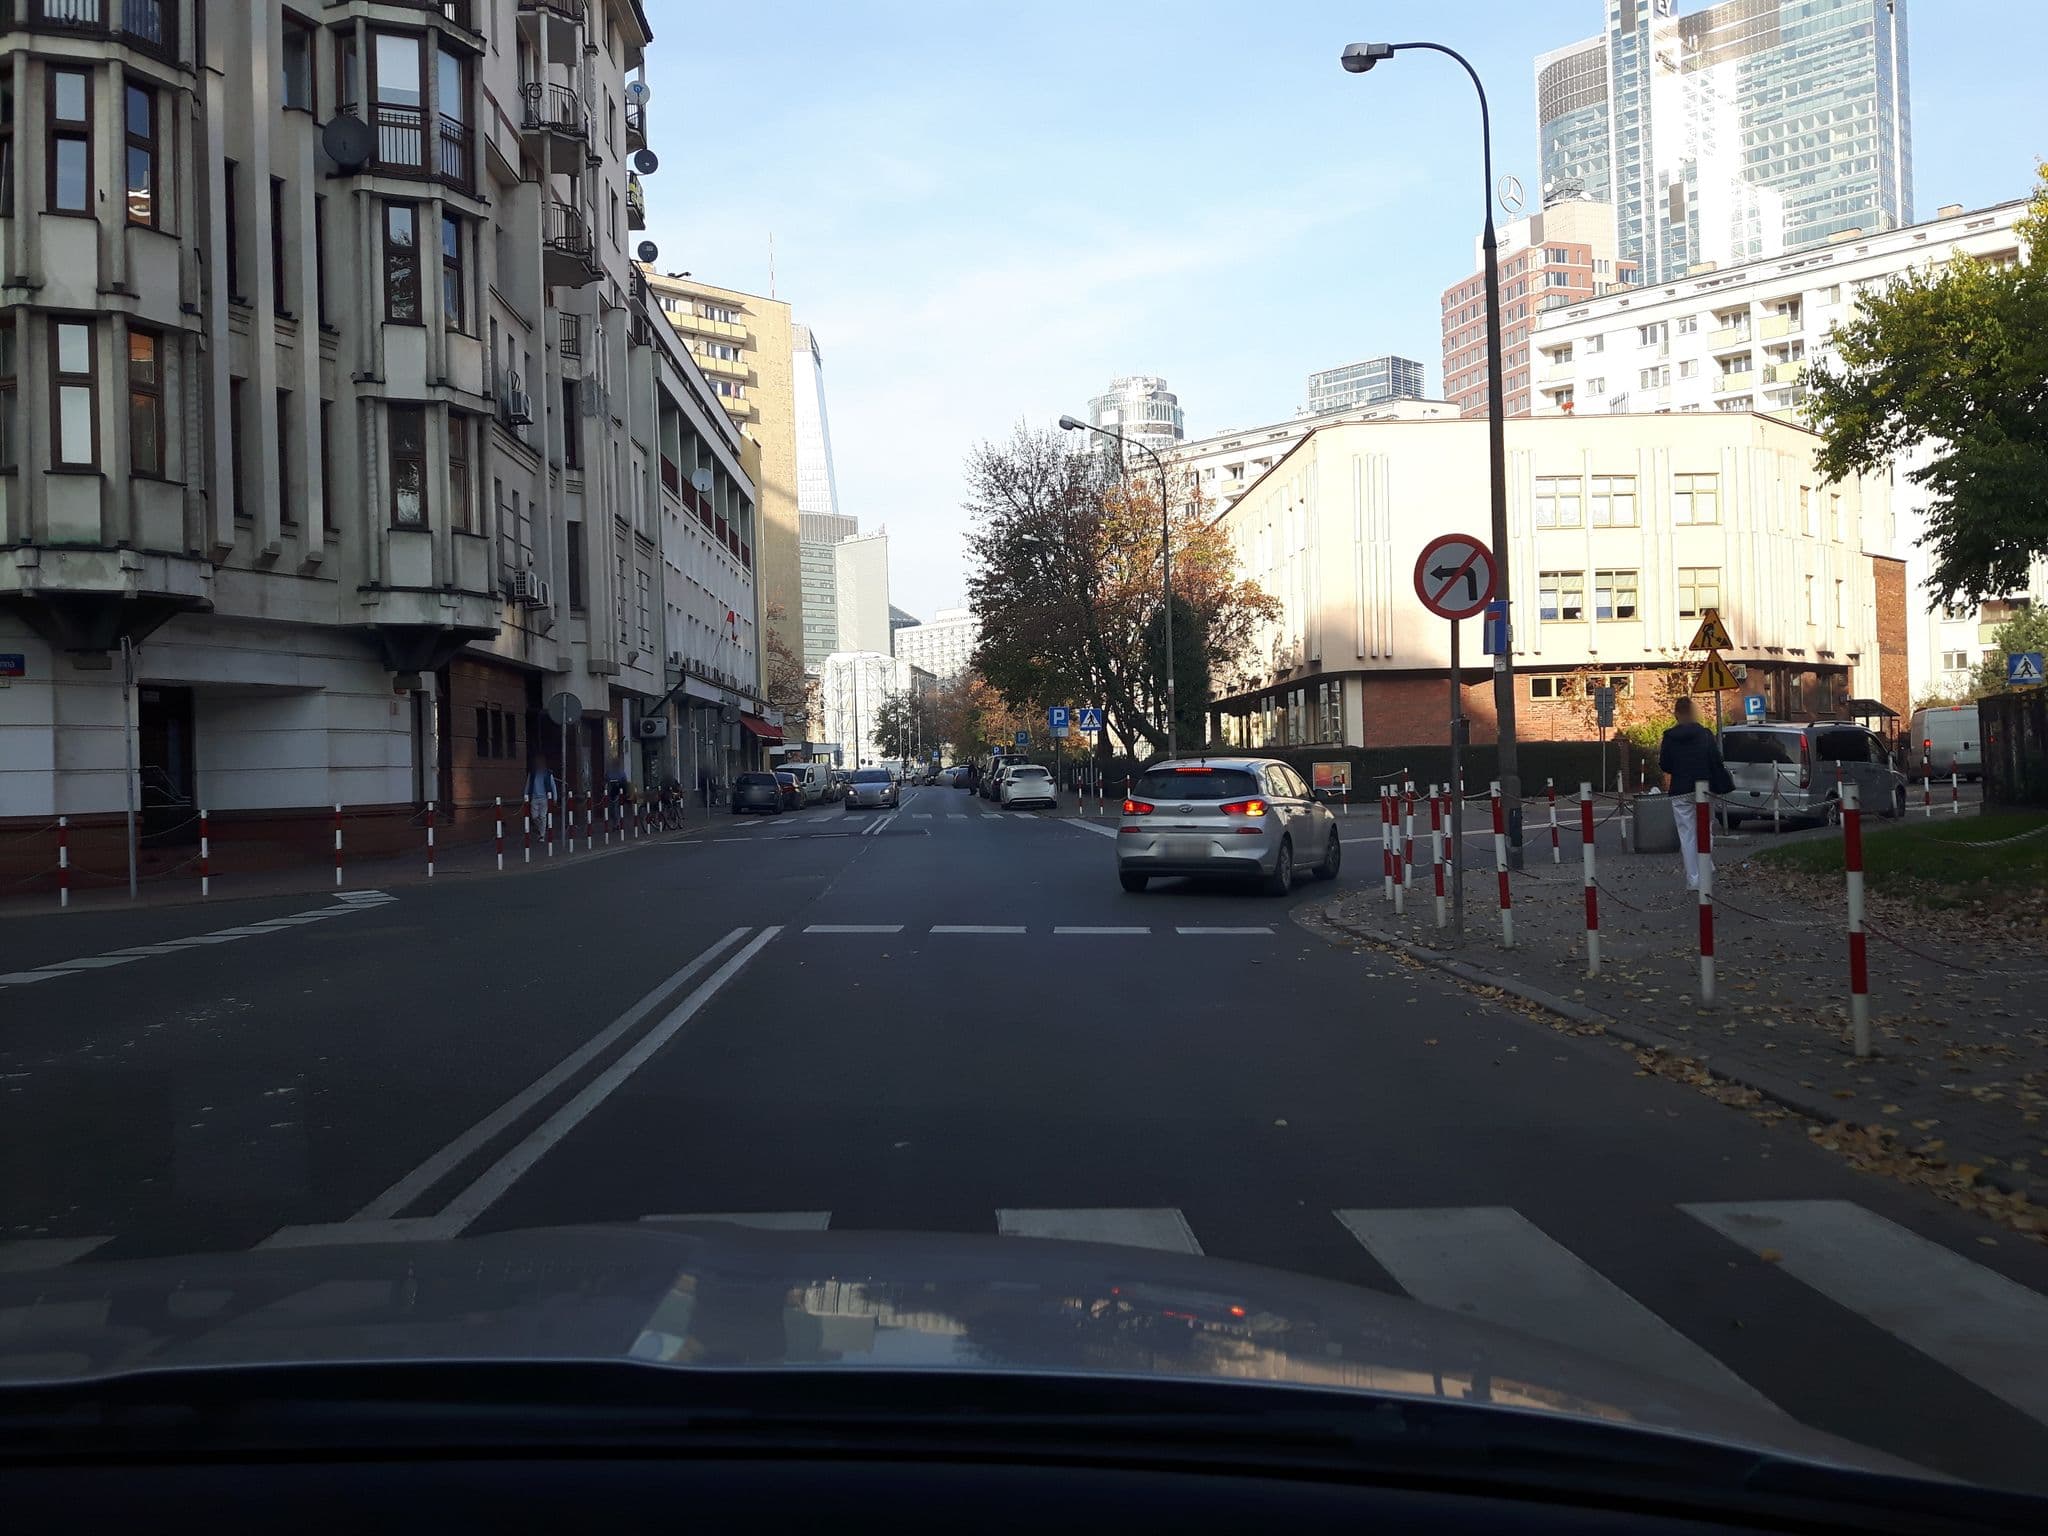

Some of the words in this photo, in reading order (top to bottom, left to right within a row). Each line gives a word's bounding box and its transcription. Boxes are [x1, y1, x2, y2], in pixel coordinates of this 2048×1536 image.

[1750, 698, 1760, 712] P
[1053, 709, 1065, 725] P
[1018, 732, 1026, 742] P
